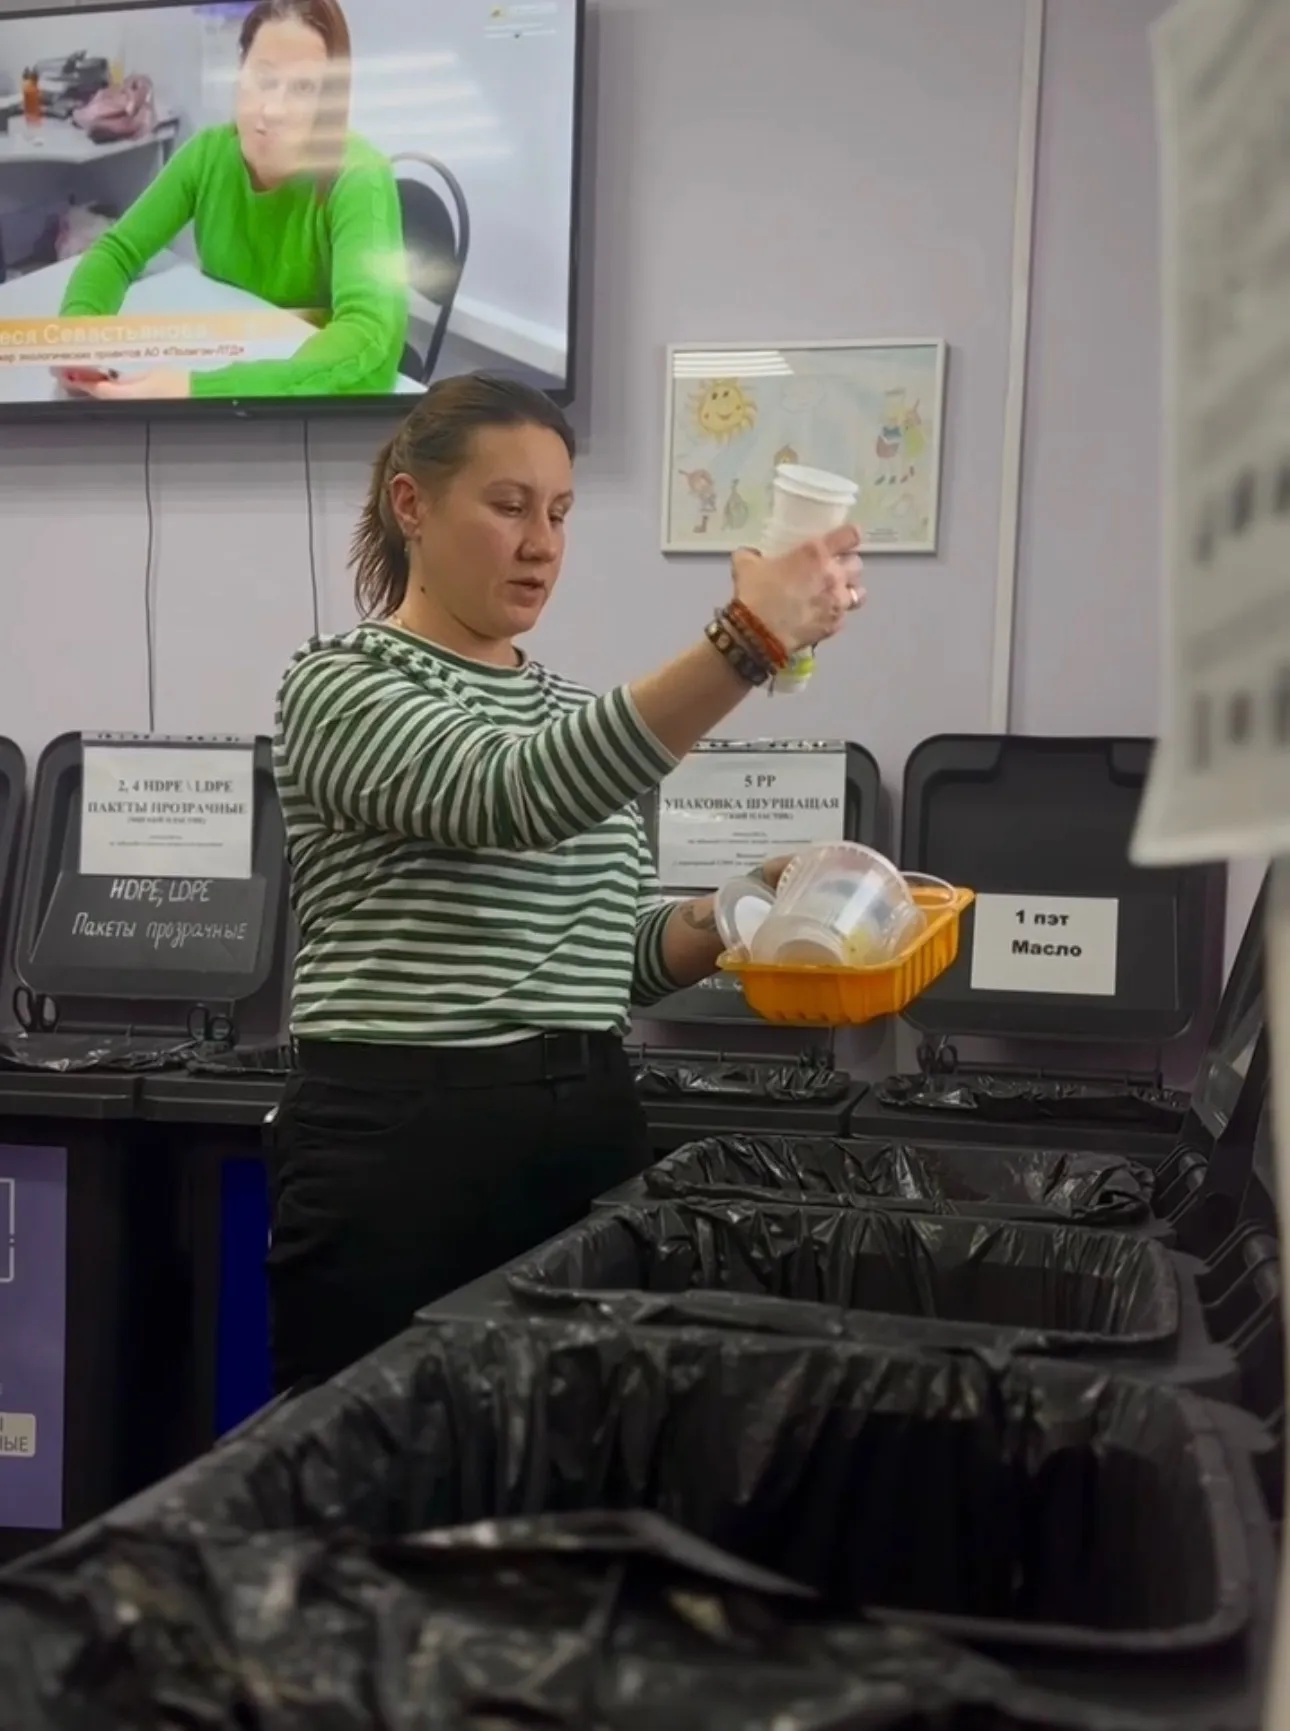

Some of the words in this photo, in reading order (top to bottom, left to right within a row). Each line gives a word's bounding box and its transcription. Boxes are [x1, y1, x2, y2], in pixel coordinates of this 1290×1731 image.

[144, 346, 160, 357] АО
[132, 780, 140, 793] 4
[143, 780, 184, 793] HDPE
[195, 780, 234, 794] LDPE
[744, 774, 753, 788] 5
[757, 774, 777, 788] PP
[87, 801, 148, 814] ПАКЕТЫ
[151, 802, 248, 815] ПРОЗРАЧНЫЕ
[664, 798, 742, 810] УПАКОВКА
[746, 797, 840, 812] ШУРШАЩАЯ
[168, 879, 214, 902] LDPE
[1015, 909, 1026, 924] 1
[1034, 913, 1070, 926] пэт
[145, 920, 249, 950] прозрачные
[1011, 939, 1083, 957] Масло
